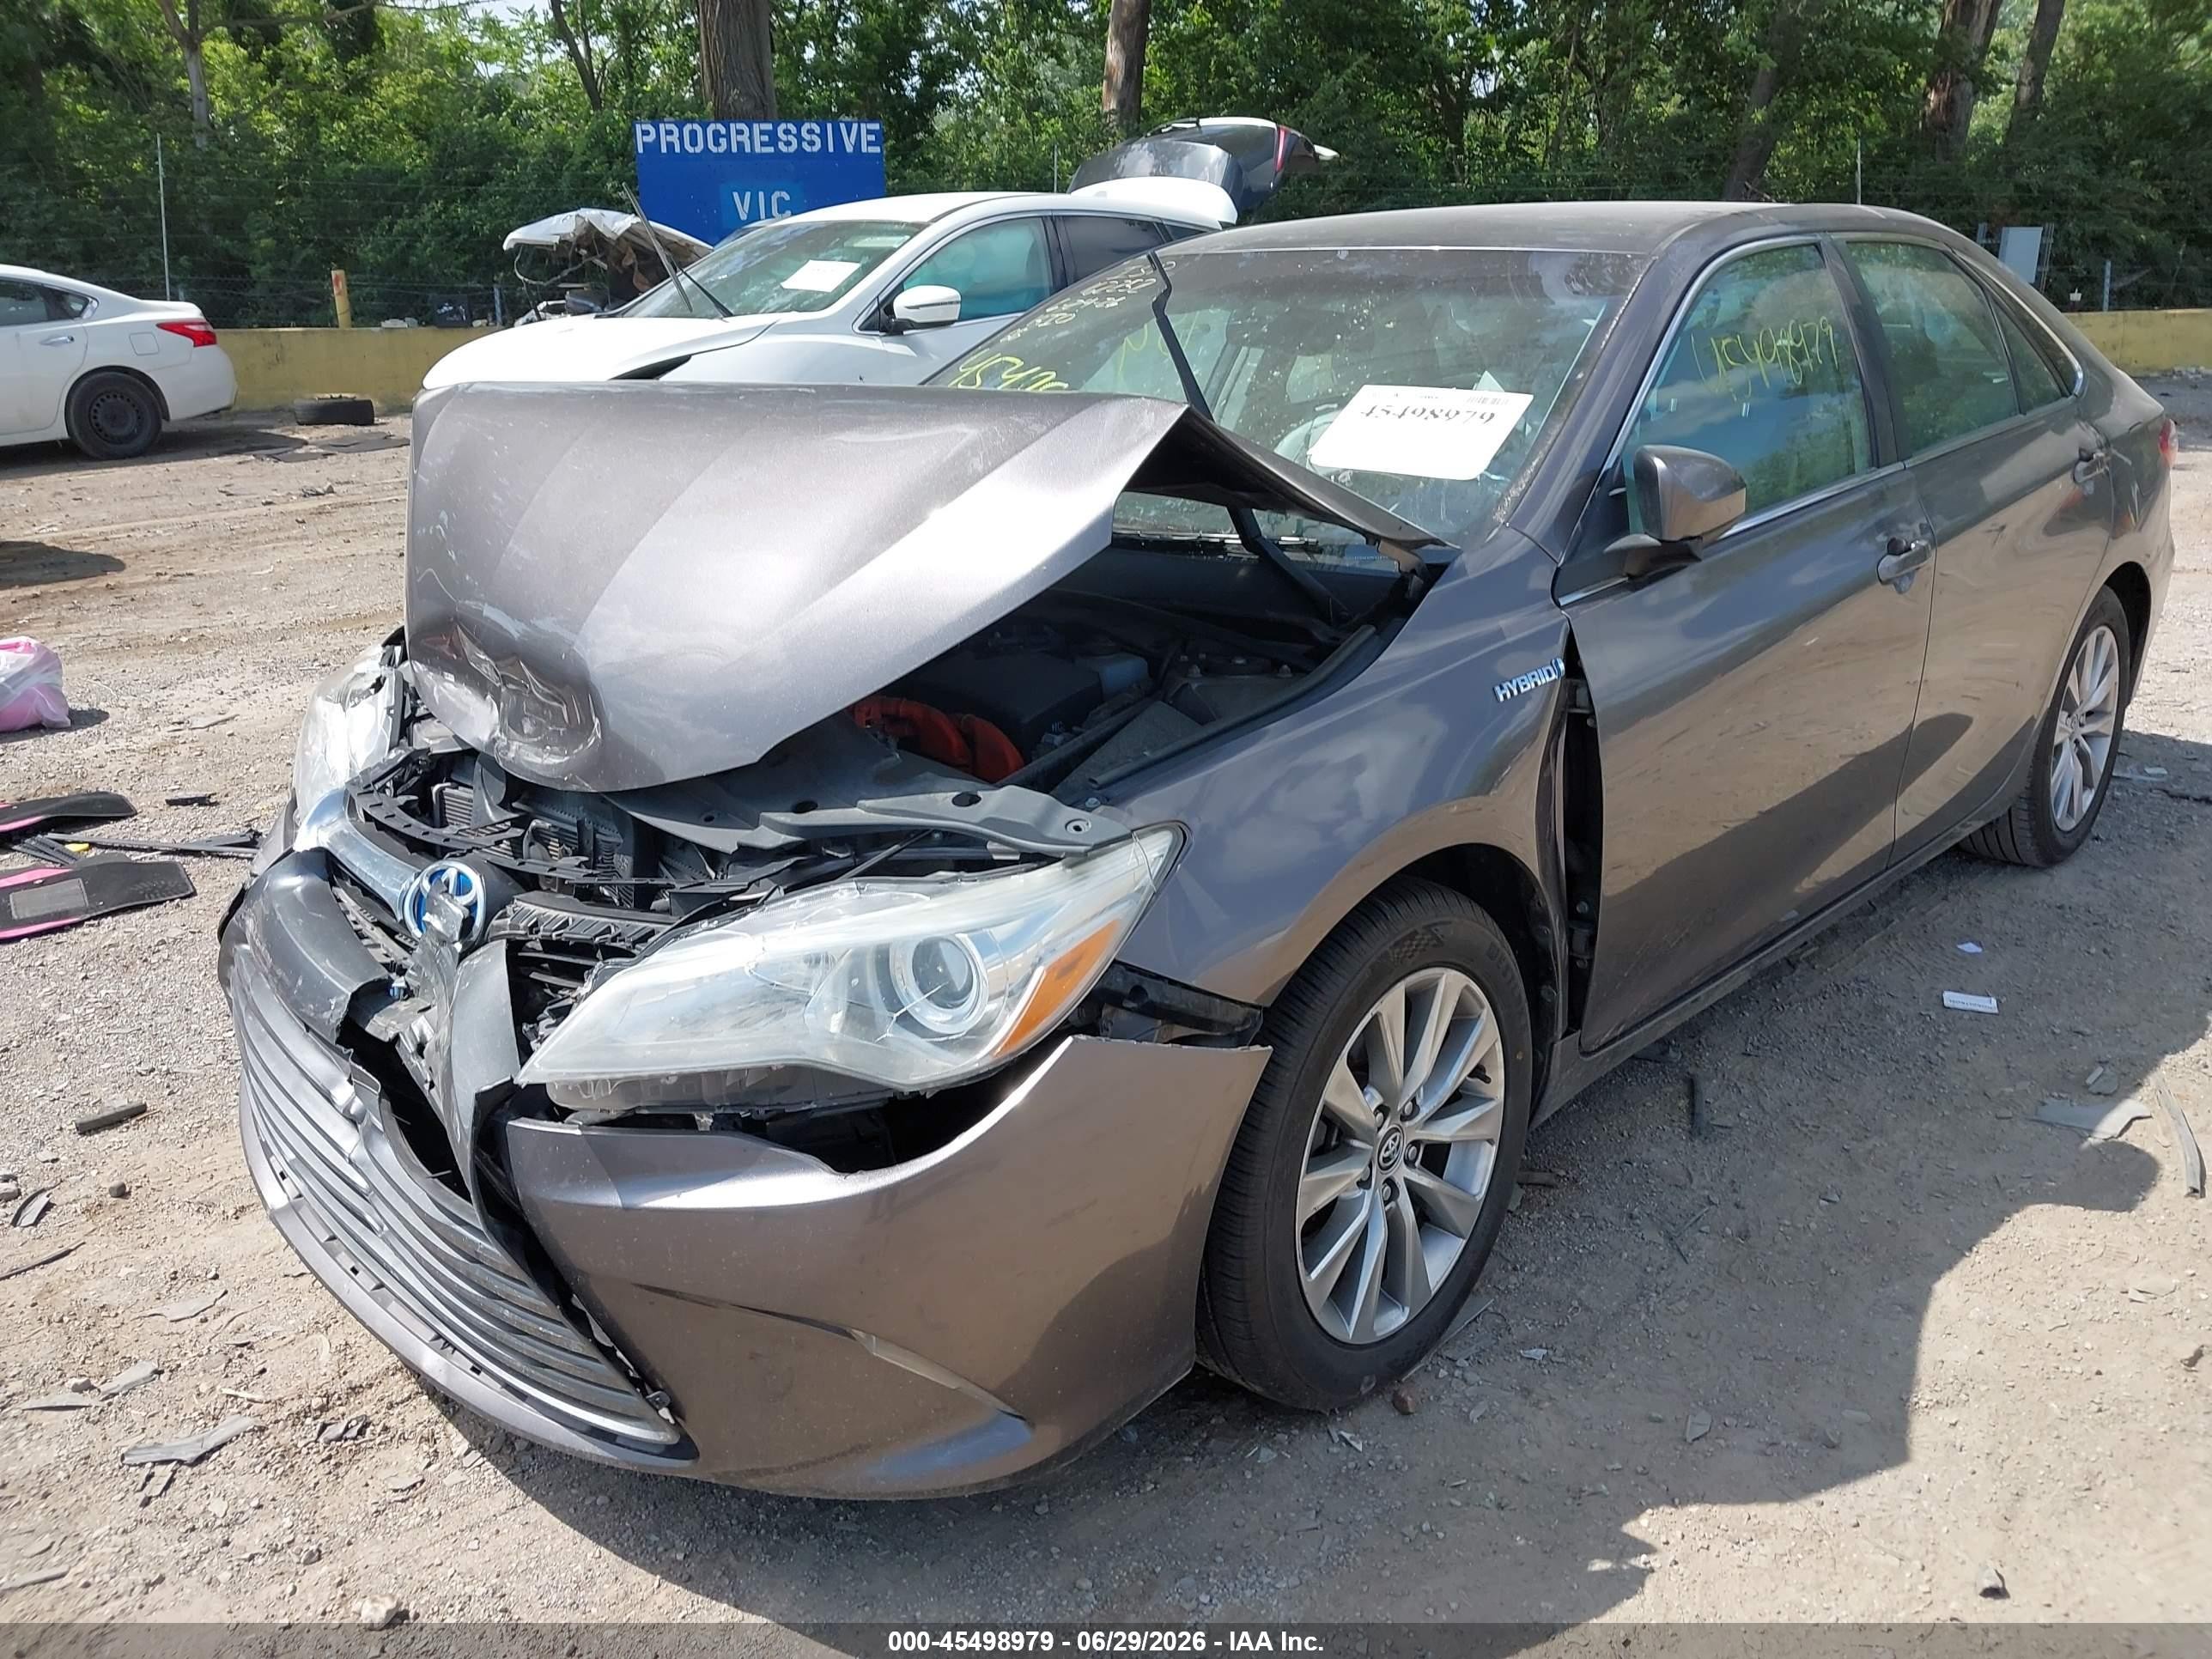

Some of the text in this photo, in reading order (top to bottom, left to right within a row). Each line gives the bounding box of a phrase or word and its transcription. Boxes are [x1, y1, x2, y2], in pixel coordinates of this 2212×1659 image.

[635, 122, 881, 154] PROGRESSIVE
[732, 191, 792, 221] VIC
[1494, 665, 1556, 702] HYBRID
